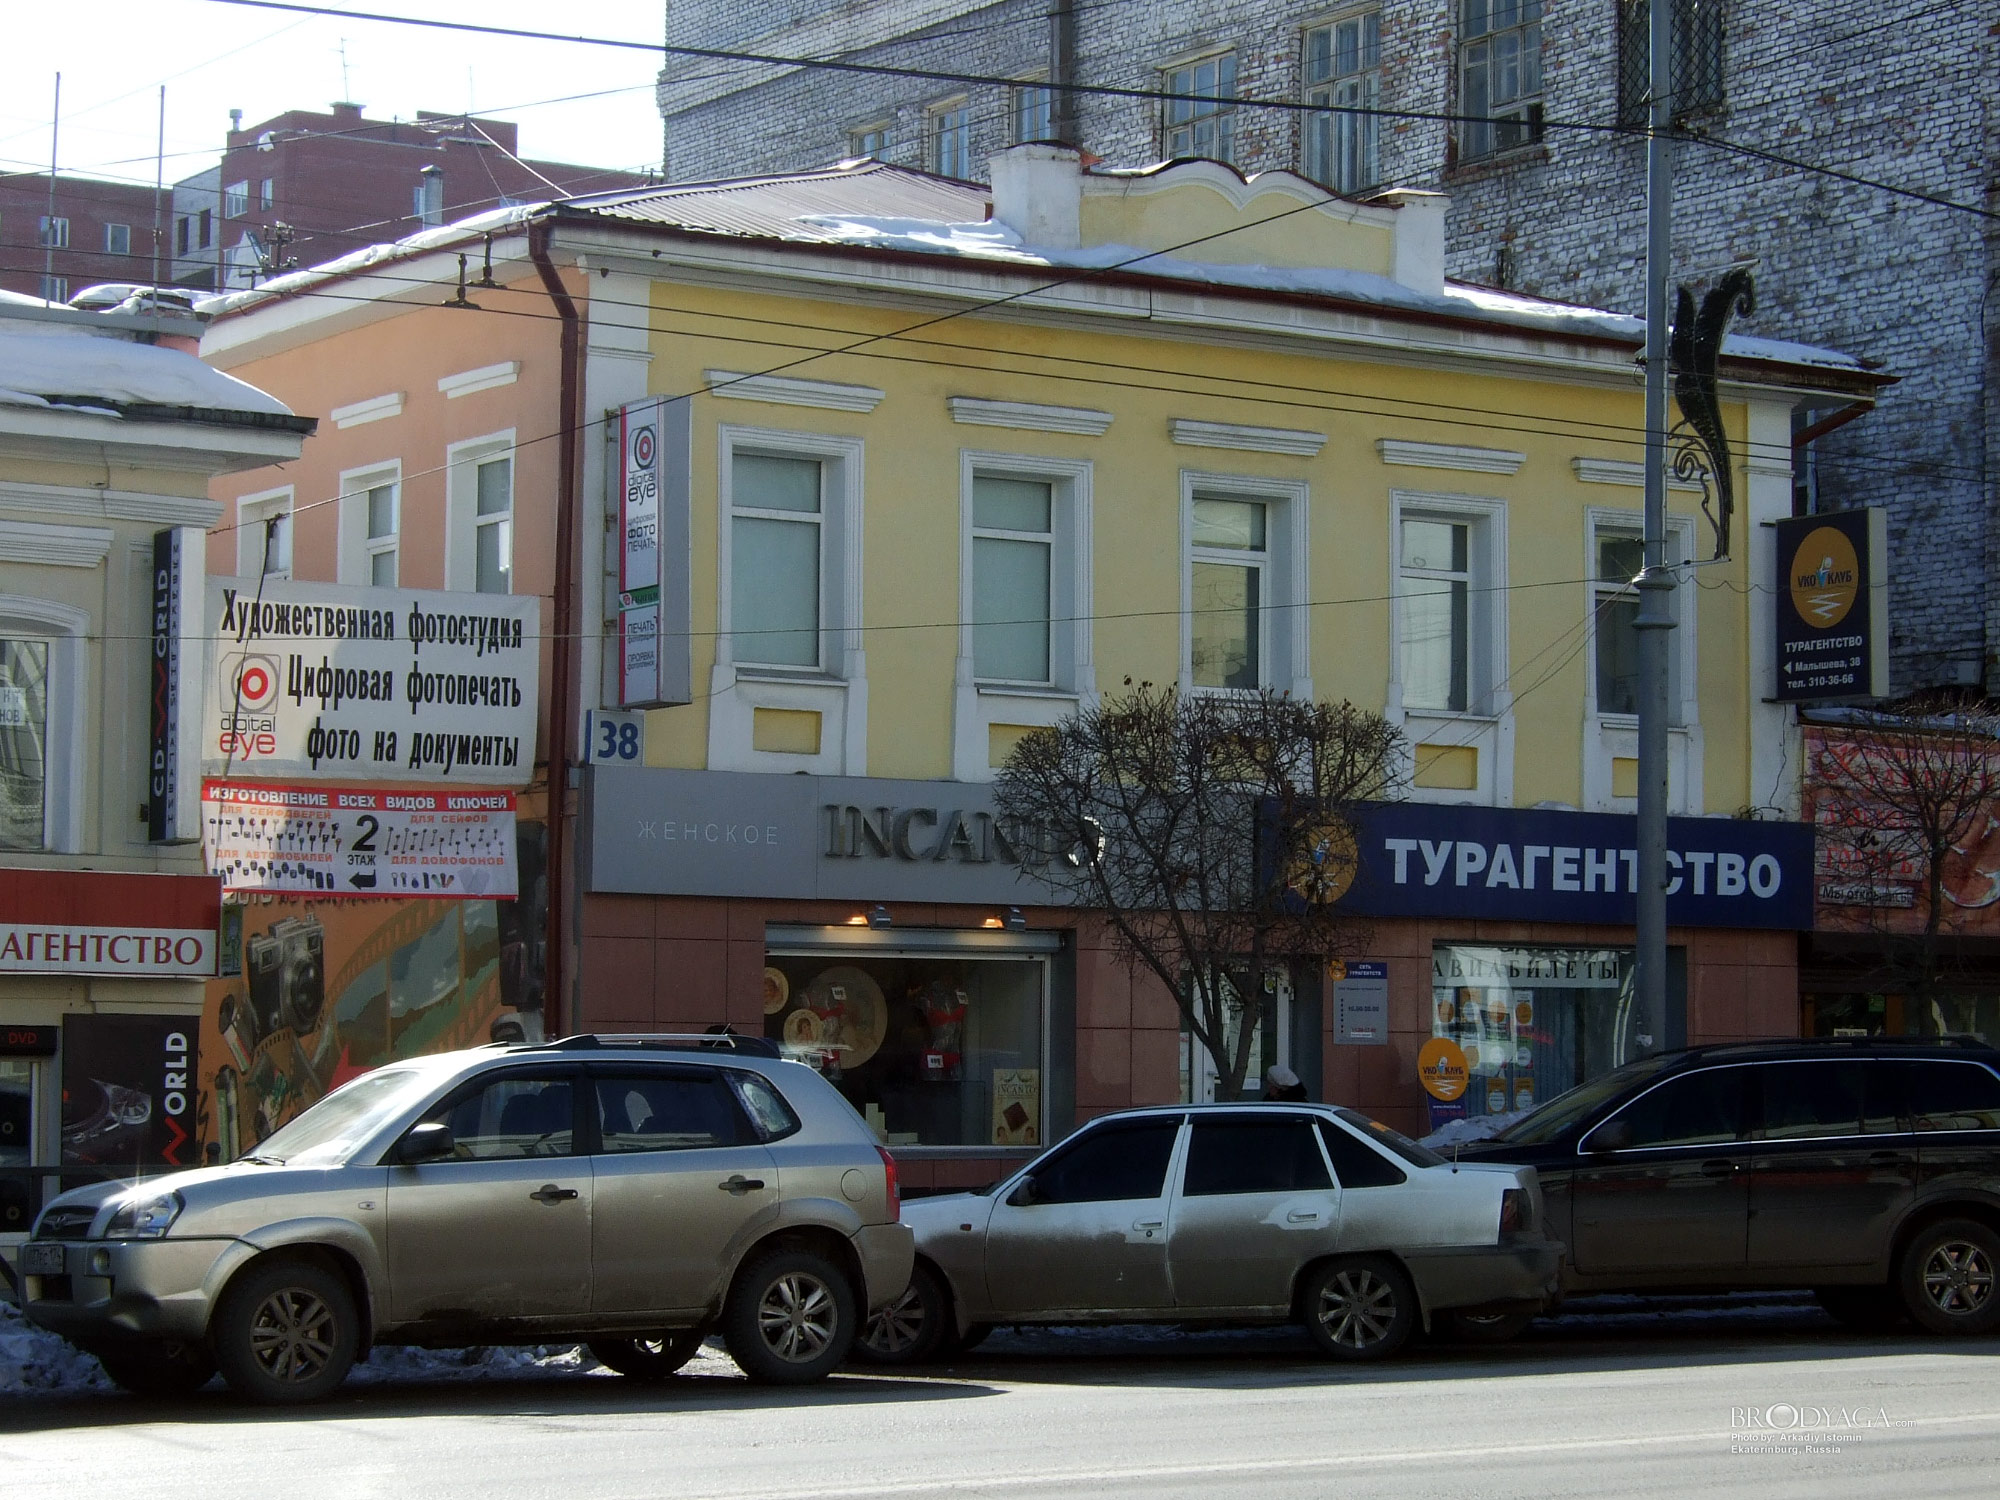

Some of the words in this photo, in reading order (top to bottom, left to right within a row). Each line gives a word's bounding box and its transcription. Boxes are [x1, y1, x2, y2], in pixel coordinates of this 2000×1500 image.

[628, 483, 656, 506] eye
[627, 537, 656, 553] ПЕЧАТЬ
[221, 588, 394, 643] Художественная
[408, 601, 522, 658] фотостудия
[627, 619, 656, 636] ПЕЧАТЬ
[1785, 635, 1863, 653] ТУРАГЕНТСТВО
[1795, 659, 1848, 673] Малышева,
[1849, 656, 1861, 668] 38
[287, 654, 393, 711] Цифровая
[407, 660, 521, 715] фотопечать
[1787, 679, 1807, 689] тел.
[220, 714, 276, 735] digital
[219, 732, 276, 761] eye
[307, 716, 360, 771] фото
[373, 730, 397, 762] на
[408, 732, 519, 775] документы
[597, 720, 639, 760] 38
[167, 722, 176, 823] МАГАЗИН
[209, 787, 328, 806] ИЗГОТОВЛЕНИЕ
[338, 794, 376, 808] ВСЕХ
[386, 796, 436, 811] ВИДОВ
[448, 796, 508, 809] КЛЮЧЕЙ
[221, 805, 243, 815] ДЛЯ
[411, 815, 435, 824] ДЛЯ
[441, 814, 488, 823] СЕЙФОВ
[351, 814, 379, 851] 2
[637, 819, 779, 846] ЖЕНСКОЕ
[217, 849, 239, 859] ДЛЯ
[245, 850, 333, 862] АВТОМОБИЛЕЙ
[347, 854, 377, 866] ЭТАЖ
[391, 856, 417, 865] ДЛЯ
[421, 857, 504, 866] ДОМОФОНОВ
[0, 932, 204, 965] АГЕНТСТВО
[1432, 958, 1619, 980] АВИАБИЛЕТЫ
[8, 1032, 38, 1045] DVD
